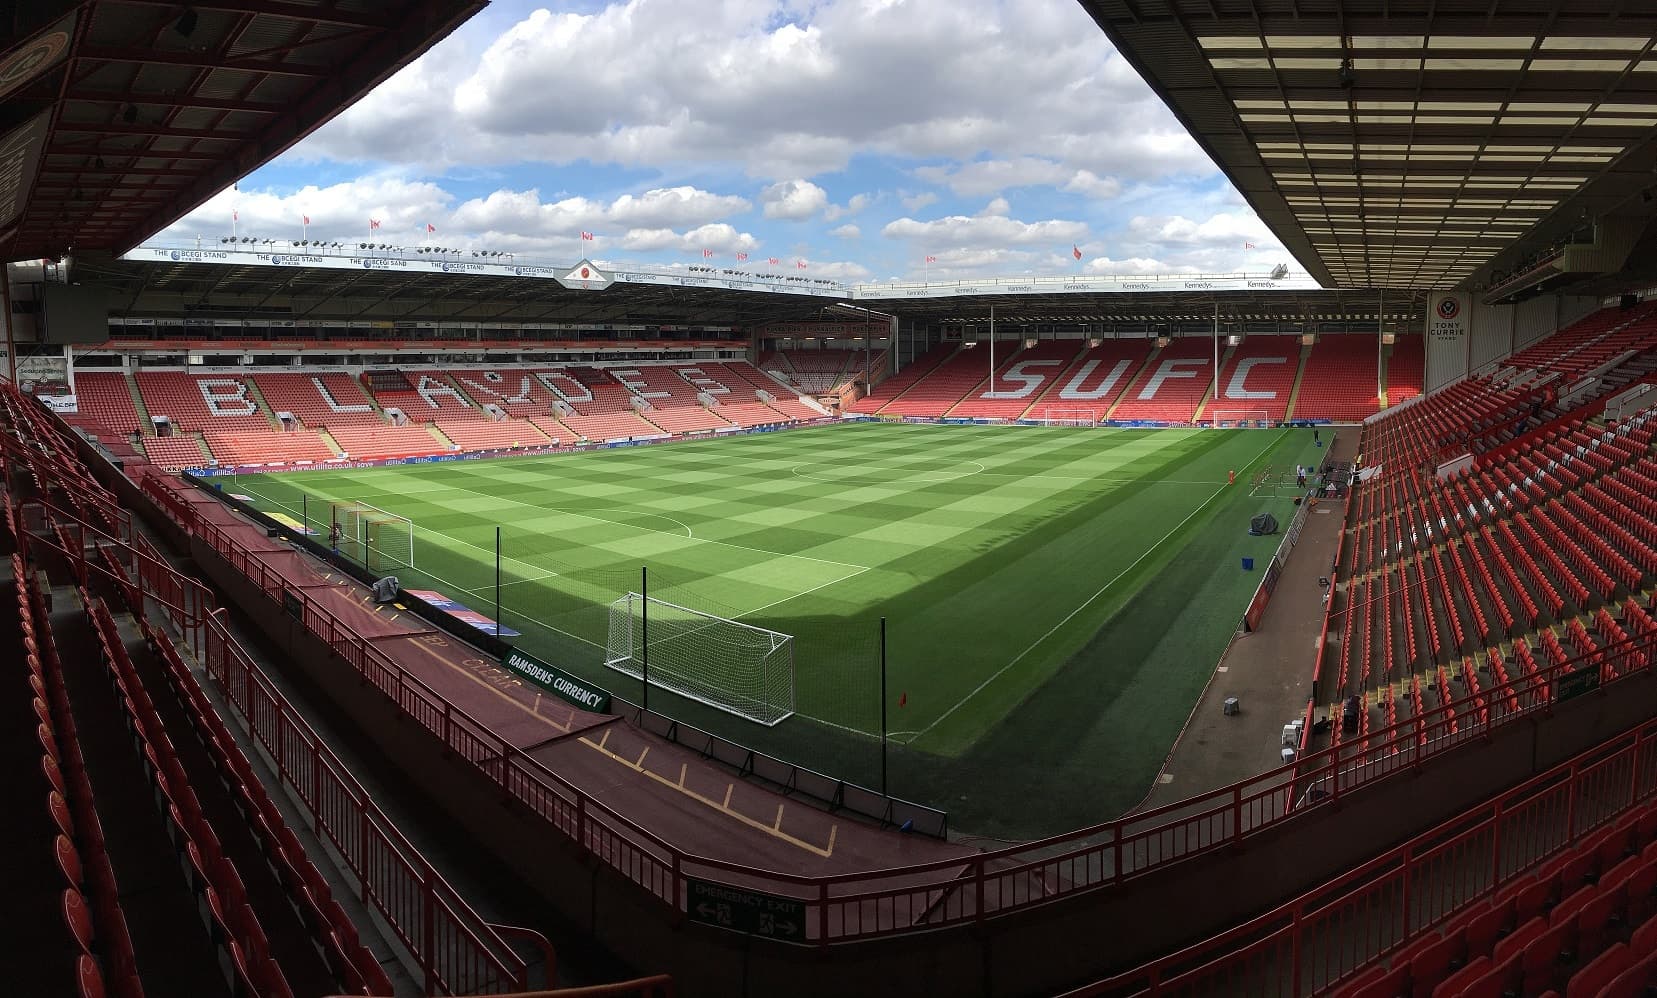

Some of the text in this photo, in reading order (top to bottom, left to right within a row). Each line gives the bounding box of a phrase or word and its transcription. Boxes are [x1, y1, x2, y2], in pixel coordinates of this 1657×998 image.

[980, 357, 1287, 399] SUFC
[508, 654, 602, 708] RAMSDENS CURRENCY
[696, 884, 798, 912] EMERGENCY EXIT
